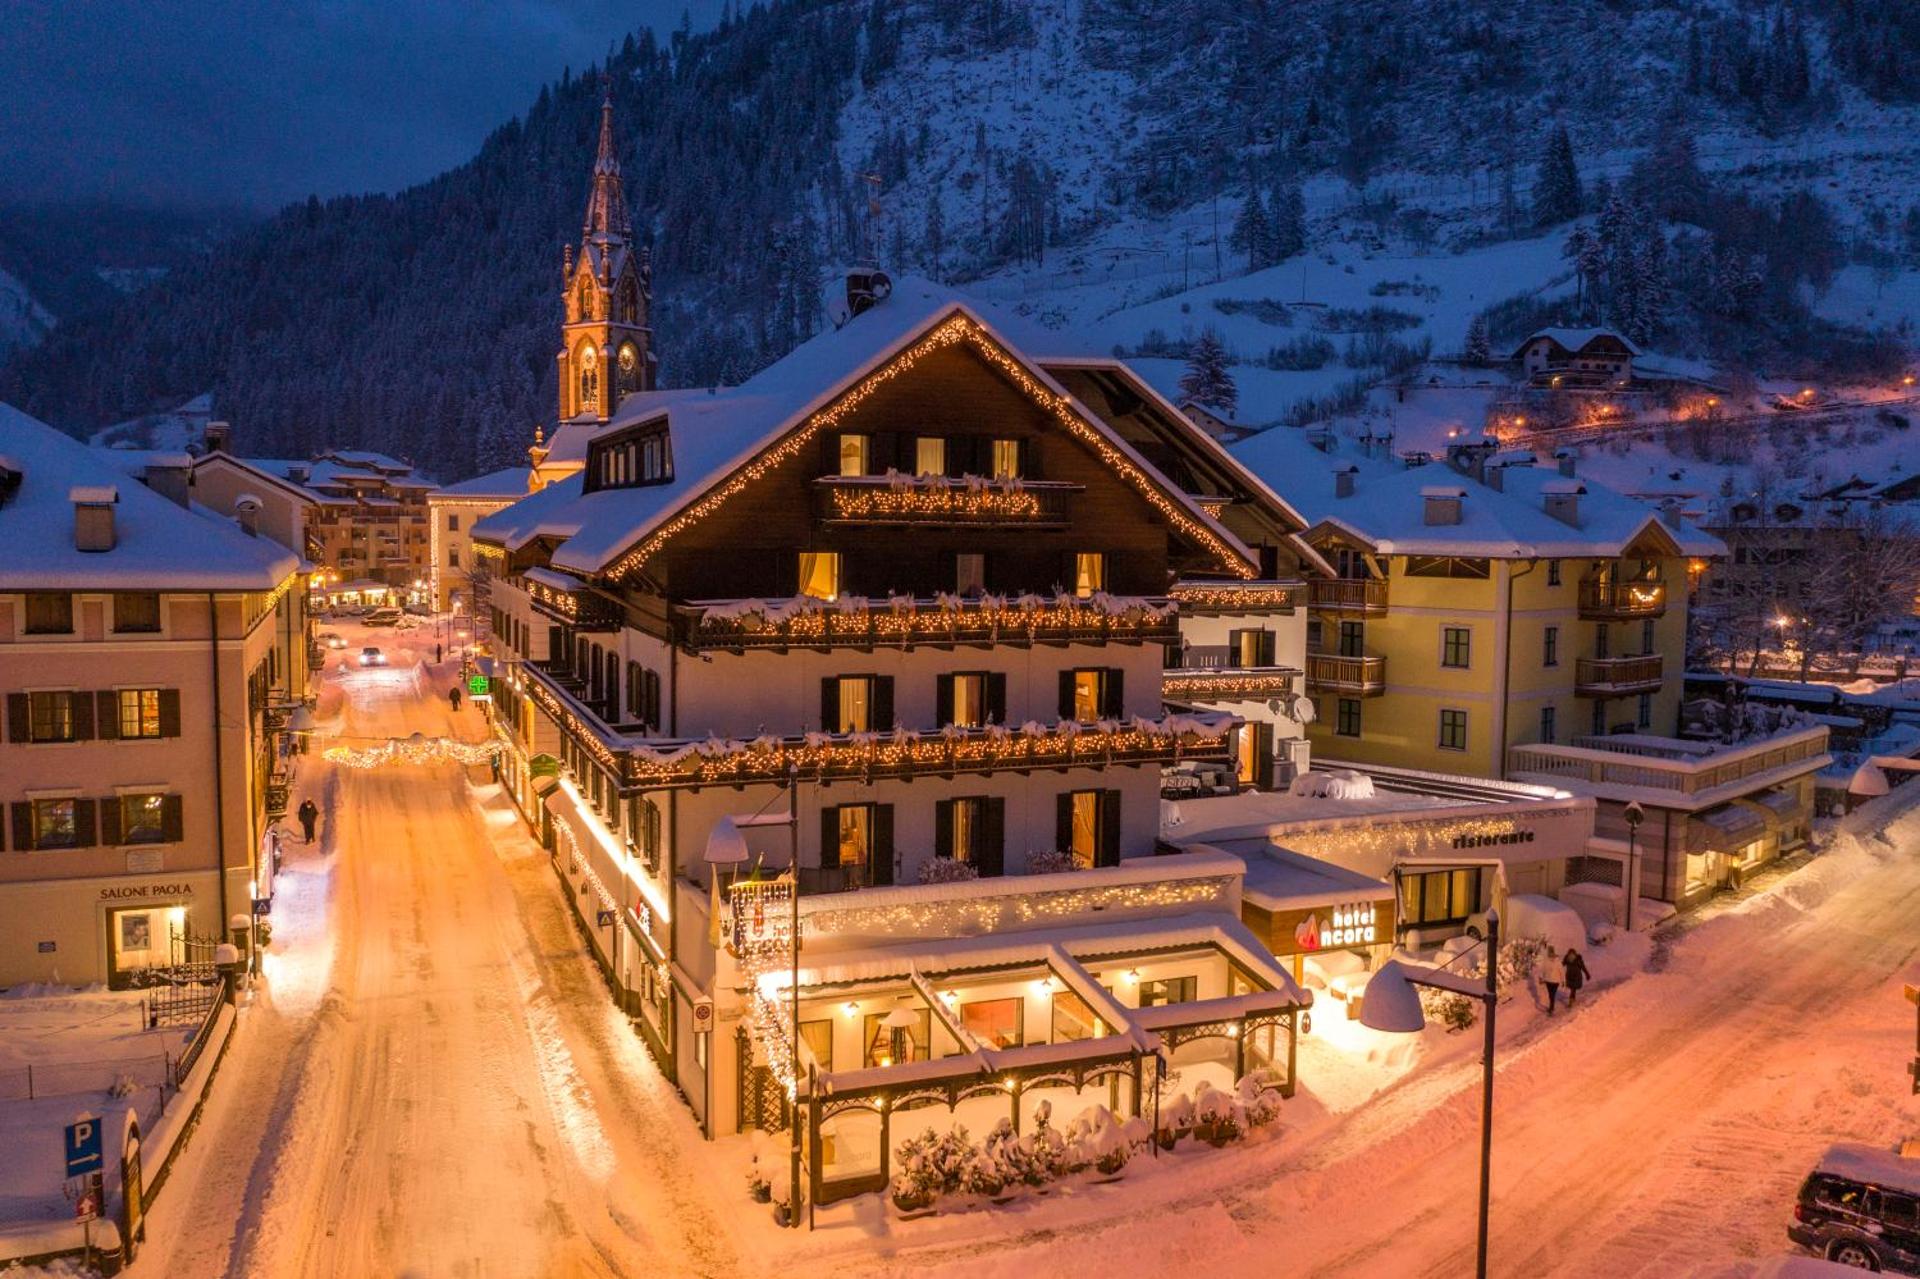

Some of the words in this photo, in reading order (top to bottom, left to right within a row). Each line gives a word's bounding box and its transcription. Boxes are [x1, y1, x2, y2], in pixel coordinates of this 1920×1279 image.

[1453, 831, 1534, 849] ristorante
[100, 886, 148, 900] SALONE
[152, 883, 192, 896] PAOLA
[1333, 907, 1376, 928] hotel
[75, 1122, 92, 1147] P
